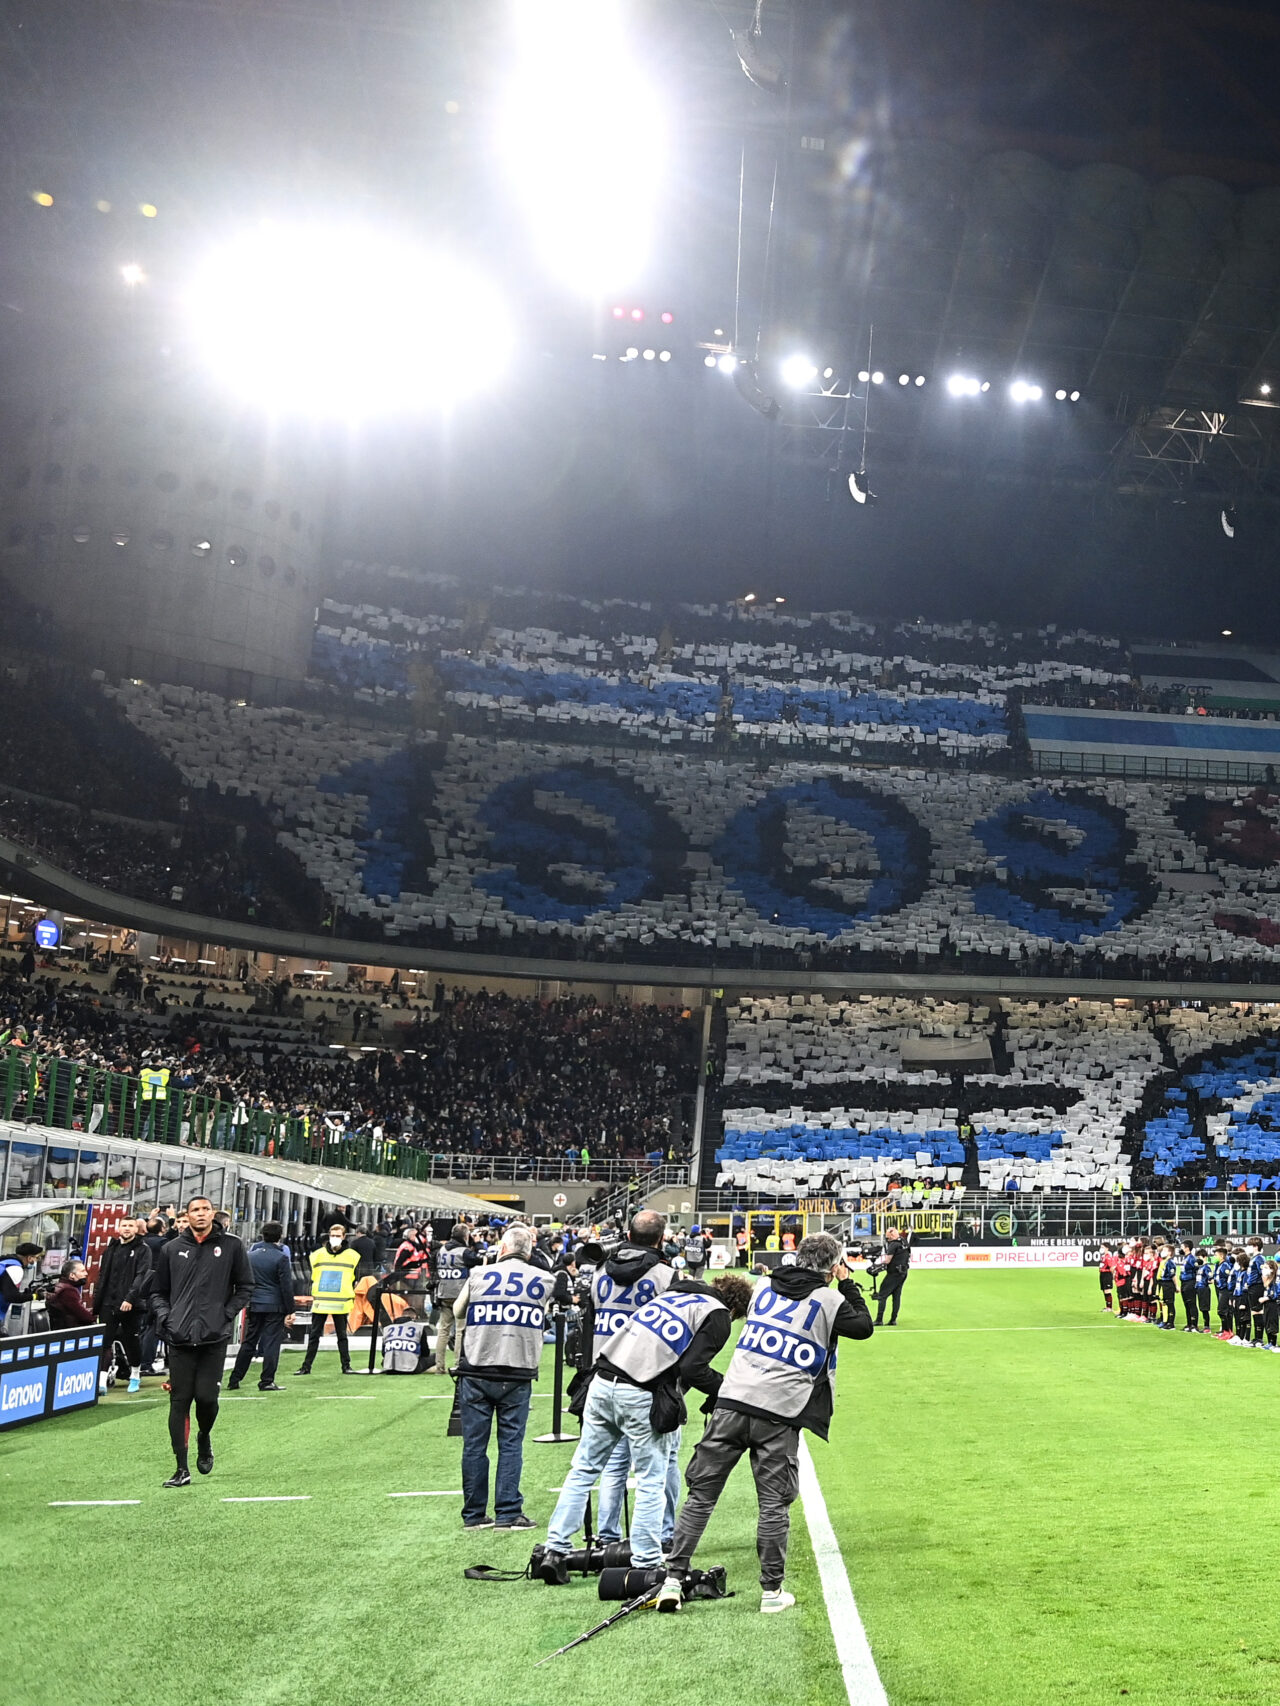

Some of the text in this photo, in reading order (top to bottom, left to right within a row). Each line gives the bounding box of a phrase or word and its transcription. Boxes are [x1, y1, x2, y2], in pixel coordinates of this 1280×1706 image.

[924, 1213, 954, 1230] UFFUG
[925, 1252, 957, 1263] care
[995, 1251, 1080, 1262] PIRELLI care
[438, 1269, 462, 1279] OTO
[481, 1271, 545, 1300] 256
[597, 1275, 655, 1307] 028
[473, 1303, 543, 1326] PHOTO
[754, 1286, 821, 1332] 021
[386, 1326, 416, 1338] 213
[594, 1312, 632, 1332] PHO
[638, 1304, 684, 1342] OTO
[57, 1371, 94, 1397] Lenovo
[1, 1382, 43, 1411] Lenovo
